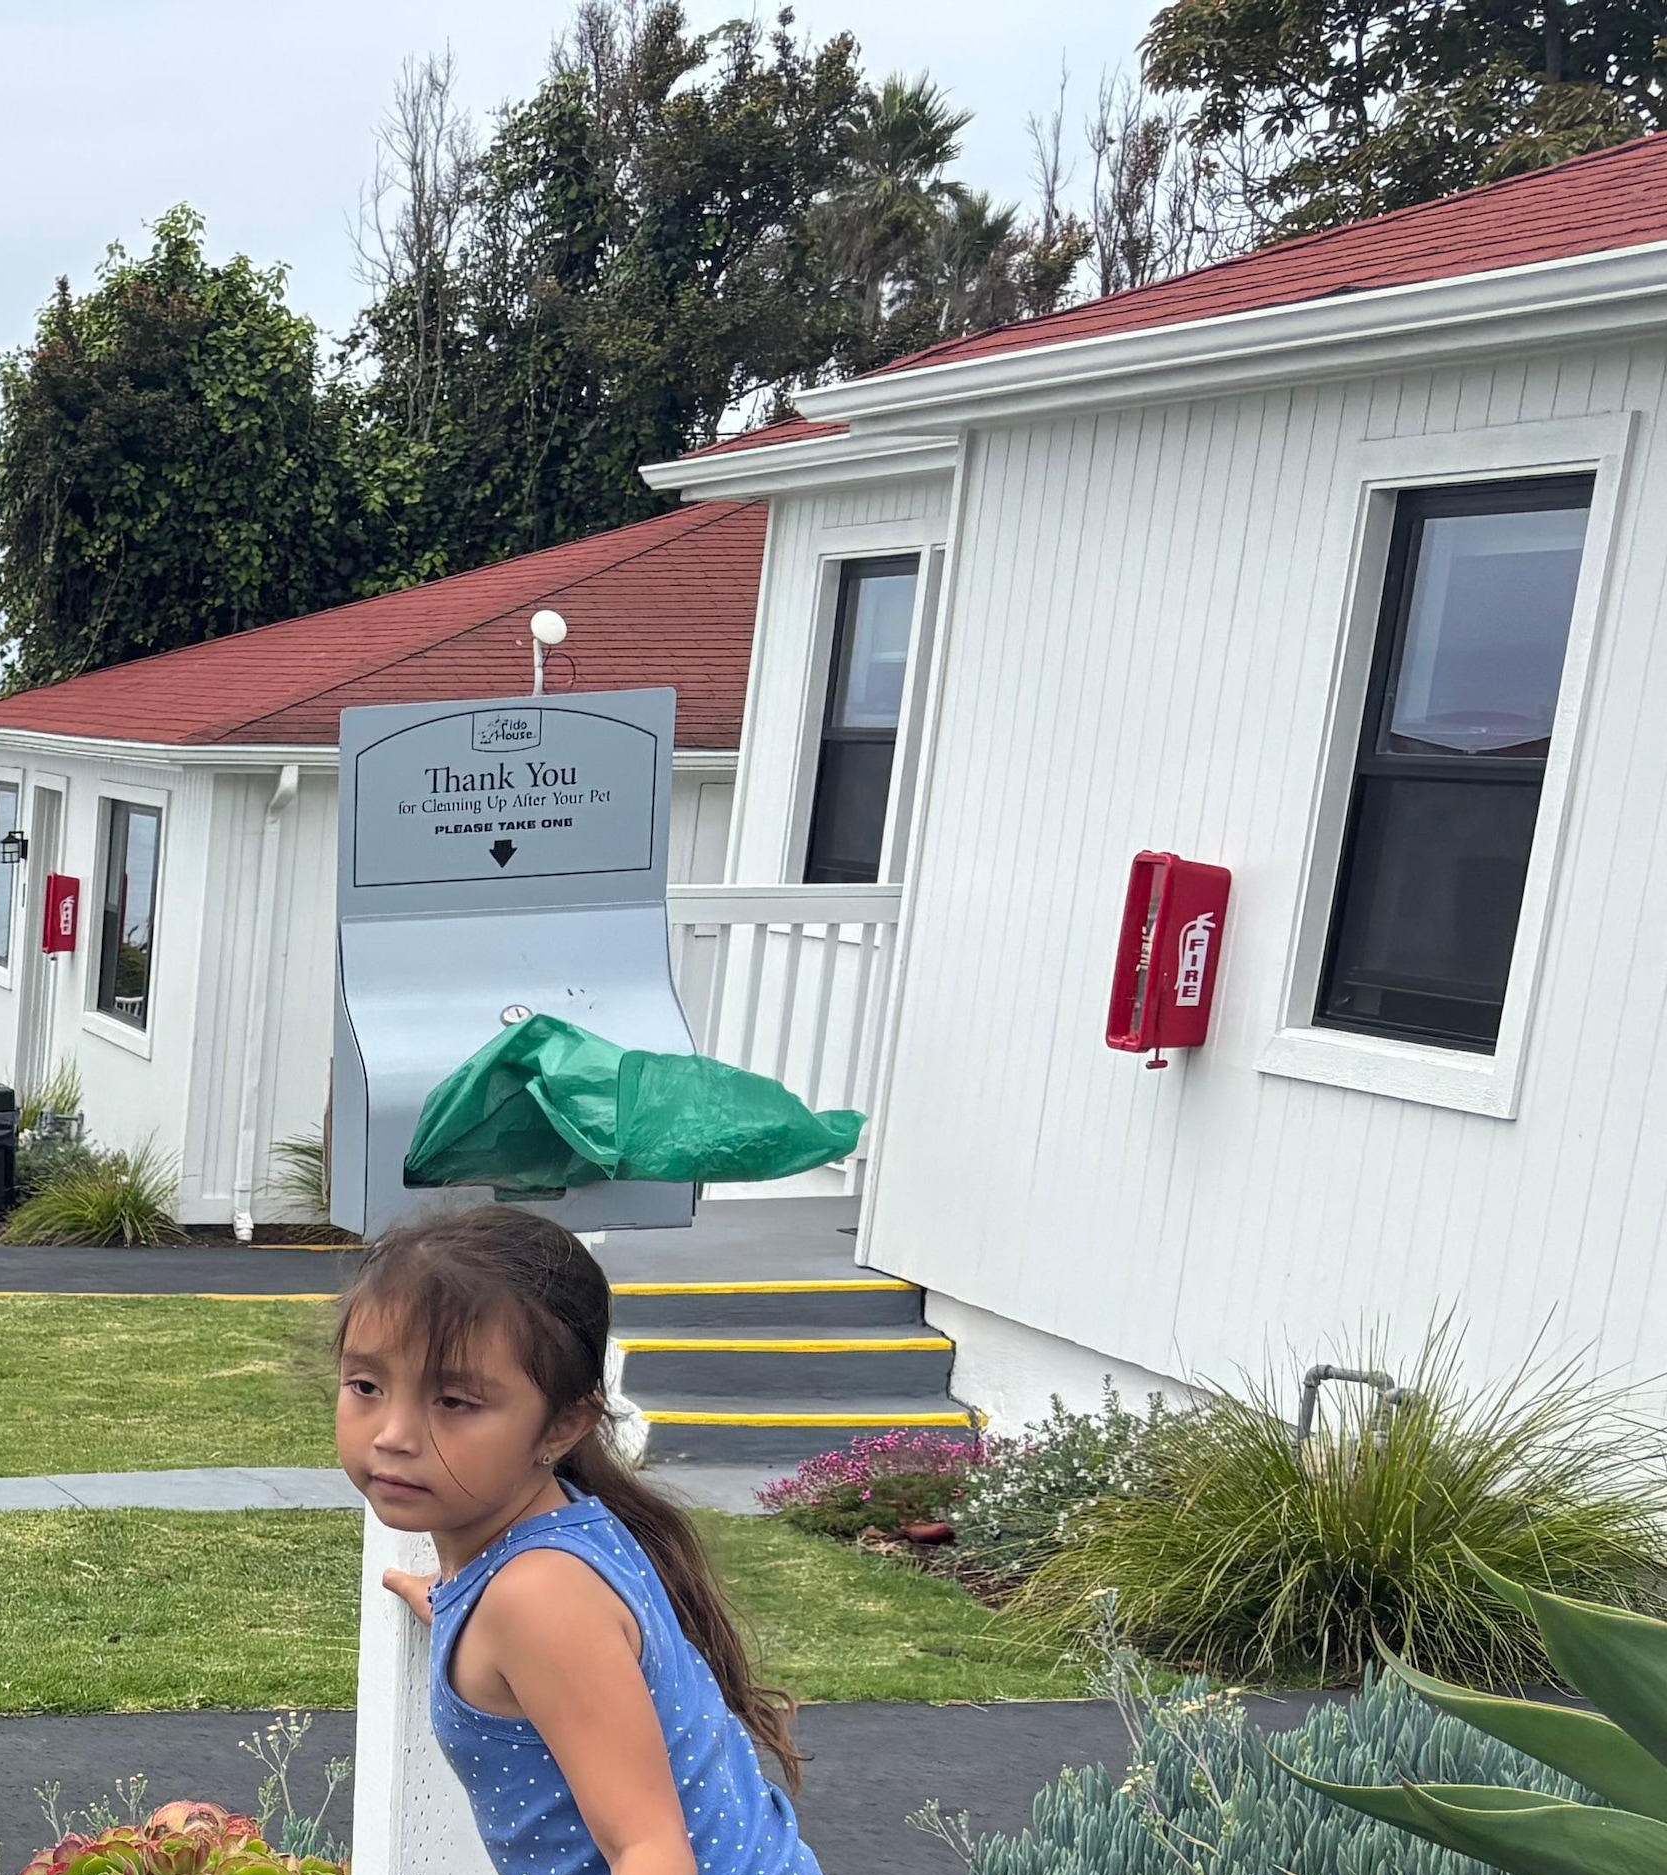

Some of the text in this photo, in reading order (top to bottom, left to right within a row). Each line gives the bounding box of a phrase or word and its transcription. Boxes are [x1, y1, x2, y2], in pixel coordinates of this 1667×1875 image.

[495, 729, 533, 741] House
[425, 761, 577, 794] Thank You
[398, 789, 611, 815] for Cleaning Up After Your Pet
[435, 817, 574, 835] PLEASE TAKE ONE
[1181, 938, 1205, 998] FIRE
